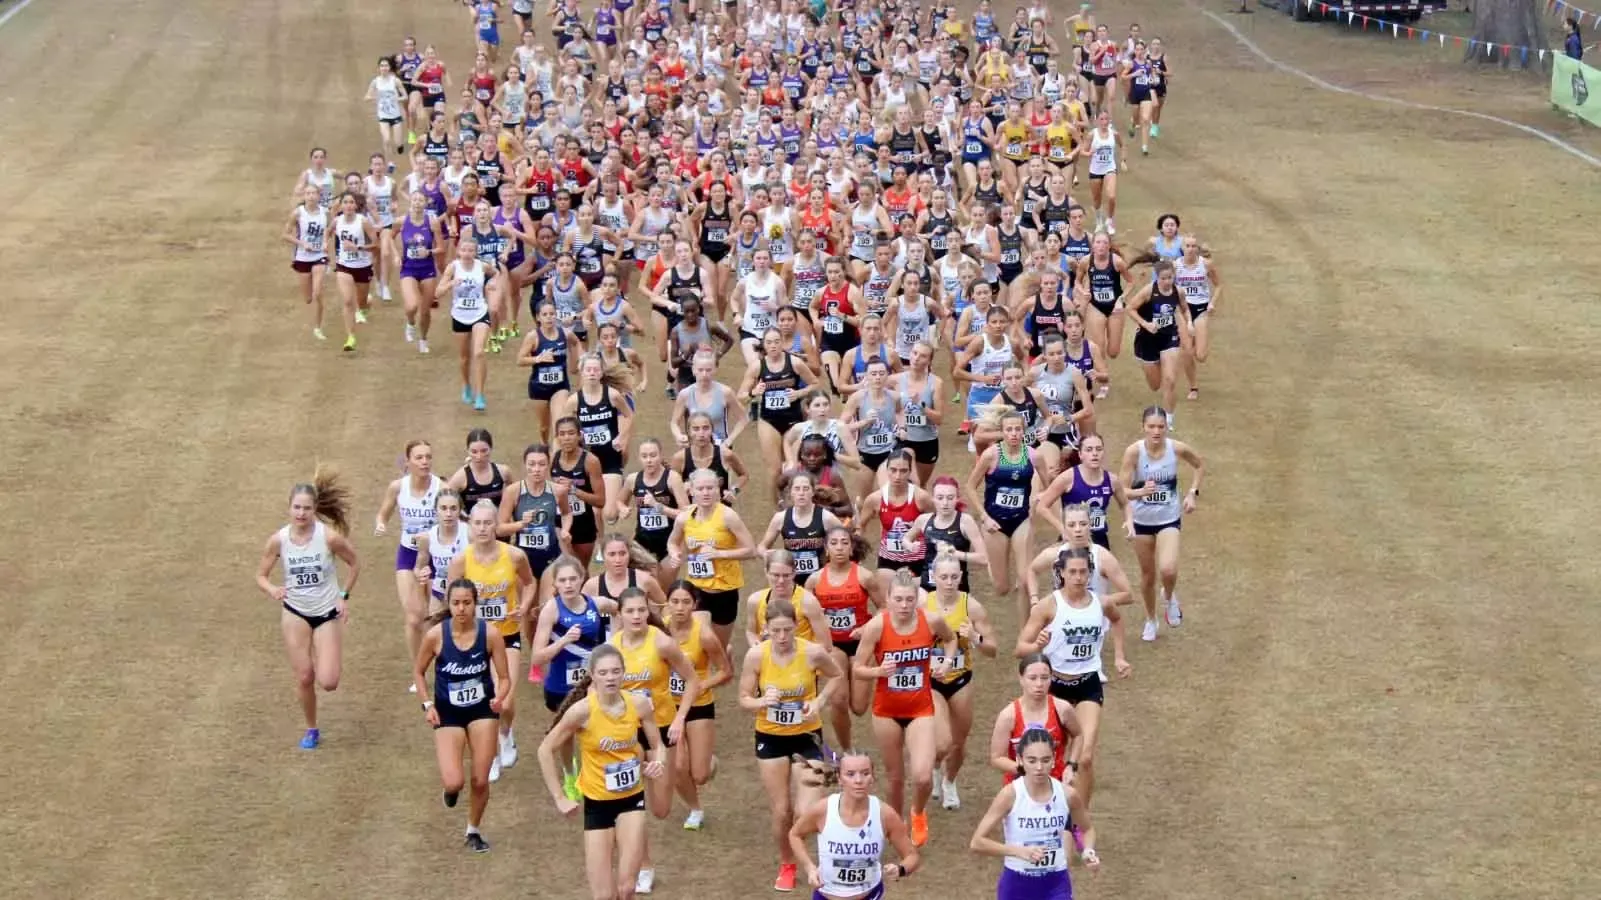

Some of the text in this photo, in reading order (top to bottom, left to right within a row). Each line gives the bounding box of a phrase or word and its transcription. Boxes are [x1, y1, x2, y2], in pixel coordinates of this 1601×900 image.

[543, 373, 559, 382] 468
[770, 397, 785, 407] 272
[905, 416, 920, 425] 104
[588, 432, 606, 443] 255
[872, 434, 888, 444] 106
[1001, 495, 1018, 507] 378
[644, 516, 662, 526] 270
[525, 535, 543, 546] 199
[691, 562, 708, 574] 194
[794, 560, 813, 571] 268
[296, 573, 319, 585] 328
[480, 605, 501, 617] 190
[829, 616, 850, 628] 223
[1062, 626, 1101, 638] WWU
[1072, 644, 1092, 657] 491
[670, 679, 686, 692] 93
[895, 674, 917, 687] 184
[456, 687, 478, 703] 472
[775, 711, 795, 723] 187
[614, 769, 636, 787] 191
[1018, 815, 1065, 828] TAYLOR
[828, 841, 879, 854] TAYLOR
[837, 867, 866, 882] 463
